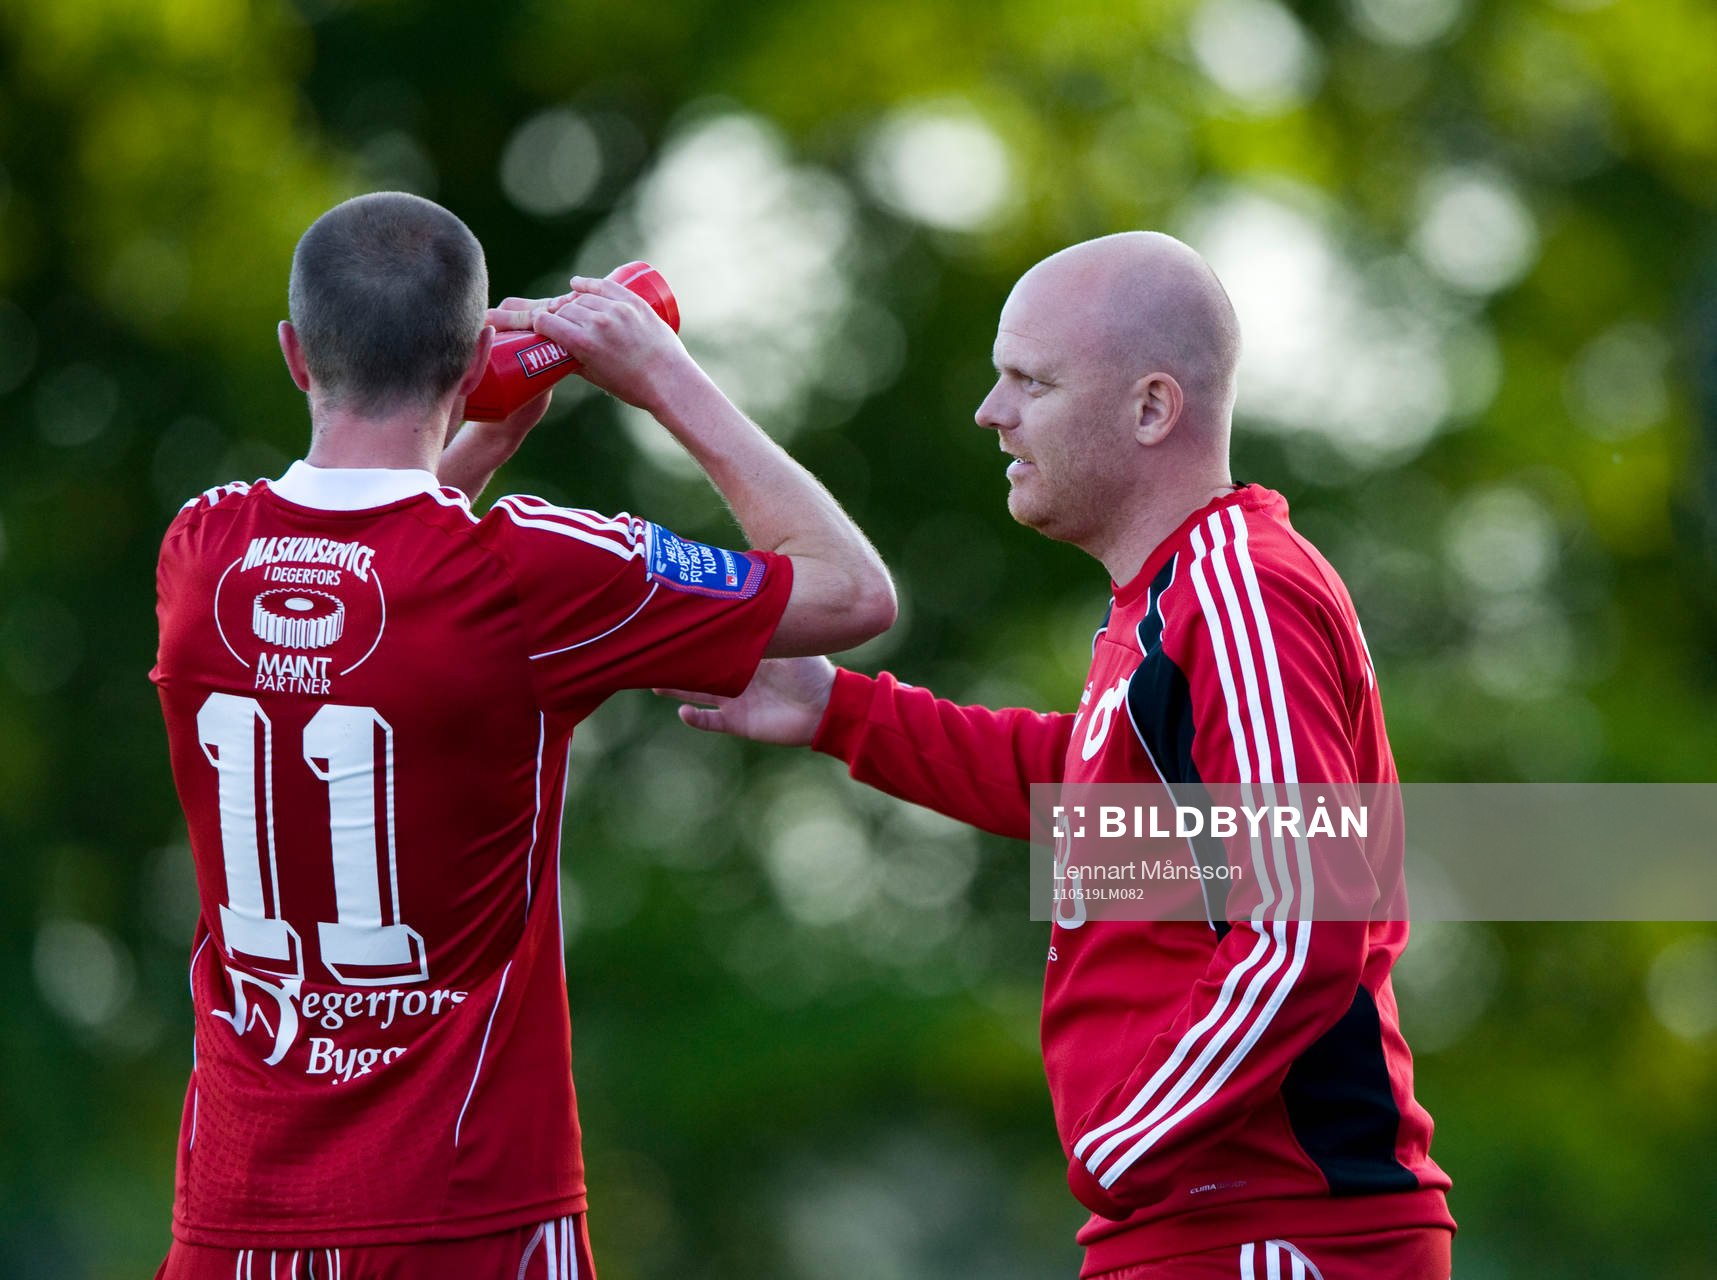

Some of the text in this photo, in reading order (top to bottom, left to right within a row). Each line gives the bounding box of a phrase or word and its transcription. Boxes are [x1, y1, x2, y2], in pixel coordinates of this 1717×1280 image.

[526, 343, 568, 370] ORTIA
[240, 536, 376, 583] MASKINSERVICE
[264, 565, 342, 586] I DEGERFORS
[257, 652, 332, 679] MAINT
[254, 673, 331, 694] PARTNER
[196, 692, 429, 986] 11
